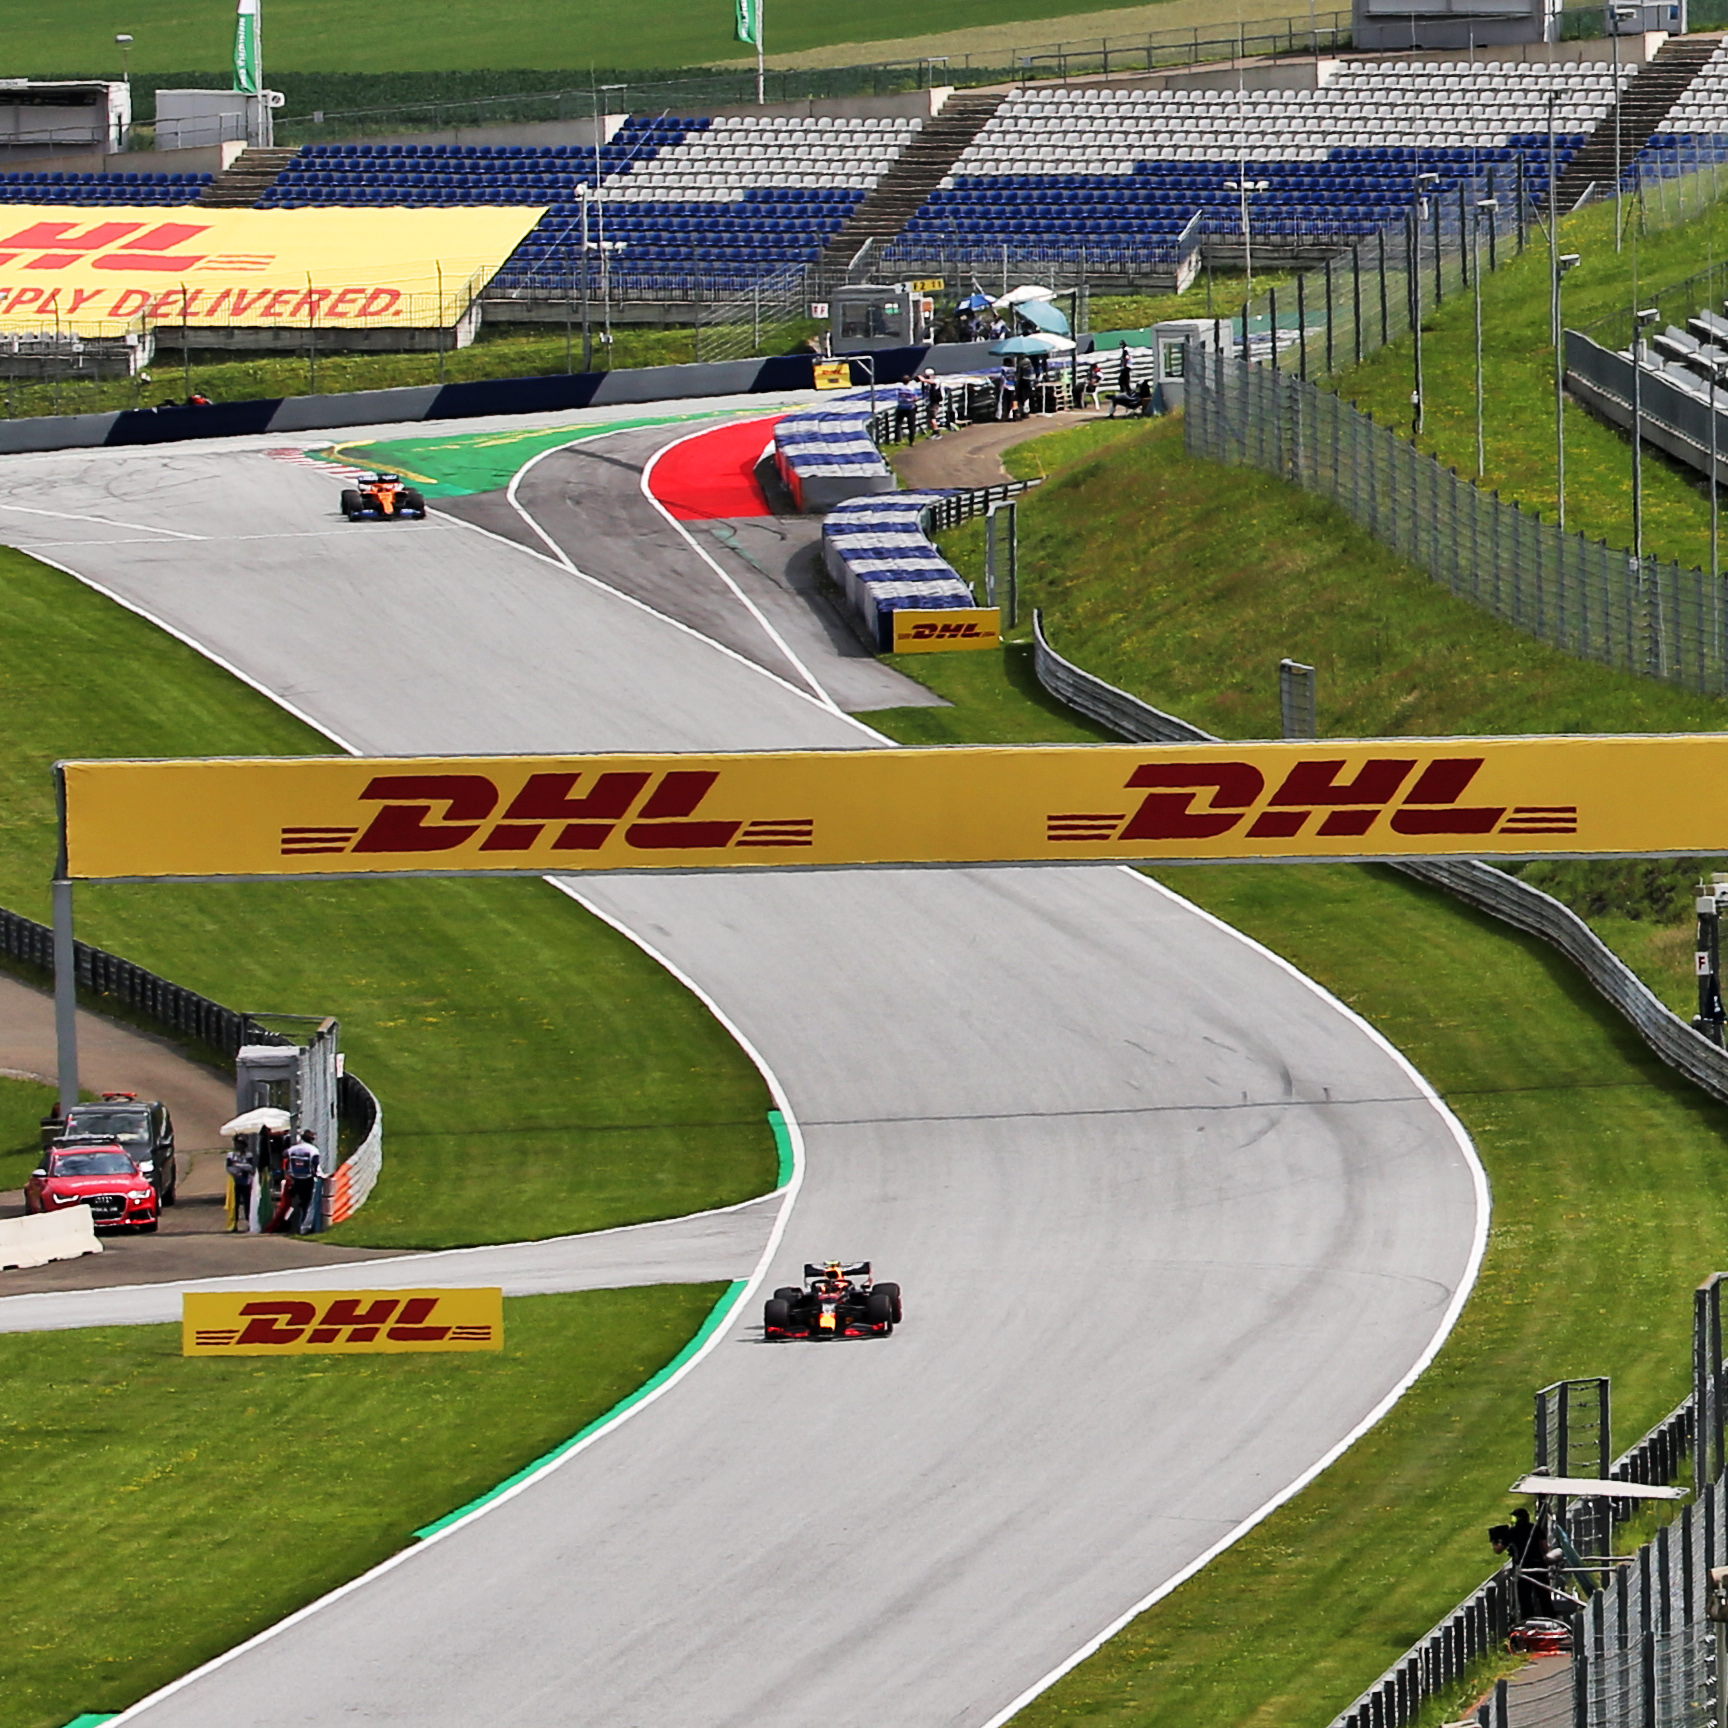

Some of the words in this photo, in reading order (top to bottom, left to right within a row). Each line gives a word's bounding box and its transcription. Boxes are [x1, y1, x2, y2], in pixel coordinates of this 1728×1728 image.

[107, 288, 402, 318] DELIVERED.
[912, 623, 978, 639] DHL
[351, 771, 743, 854] DHL
[1118, 758, 1506, 841] DHL
[1698, 956, 1705, 970] F
[236, 1298, 452, 1345] DHL
